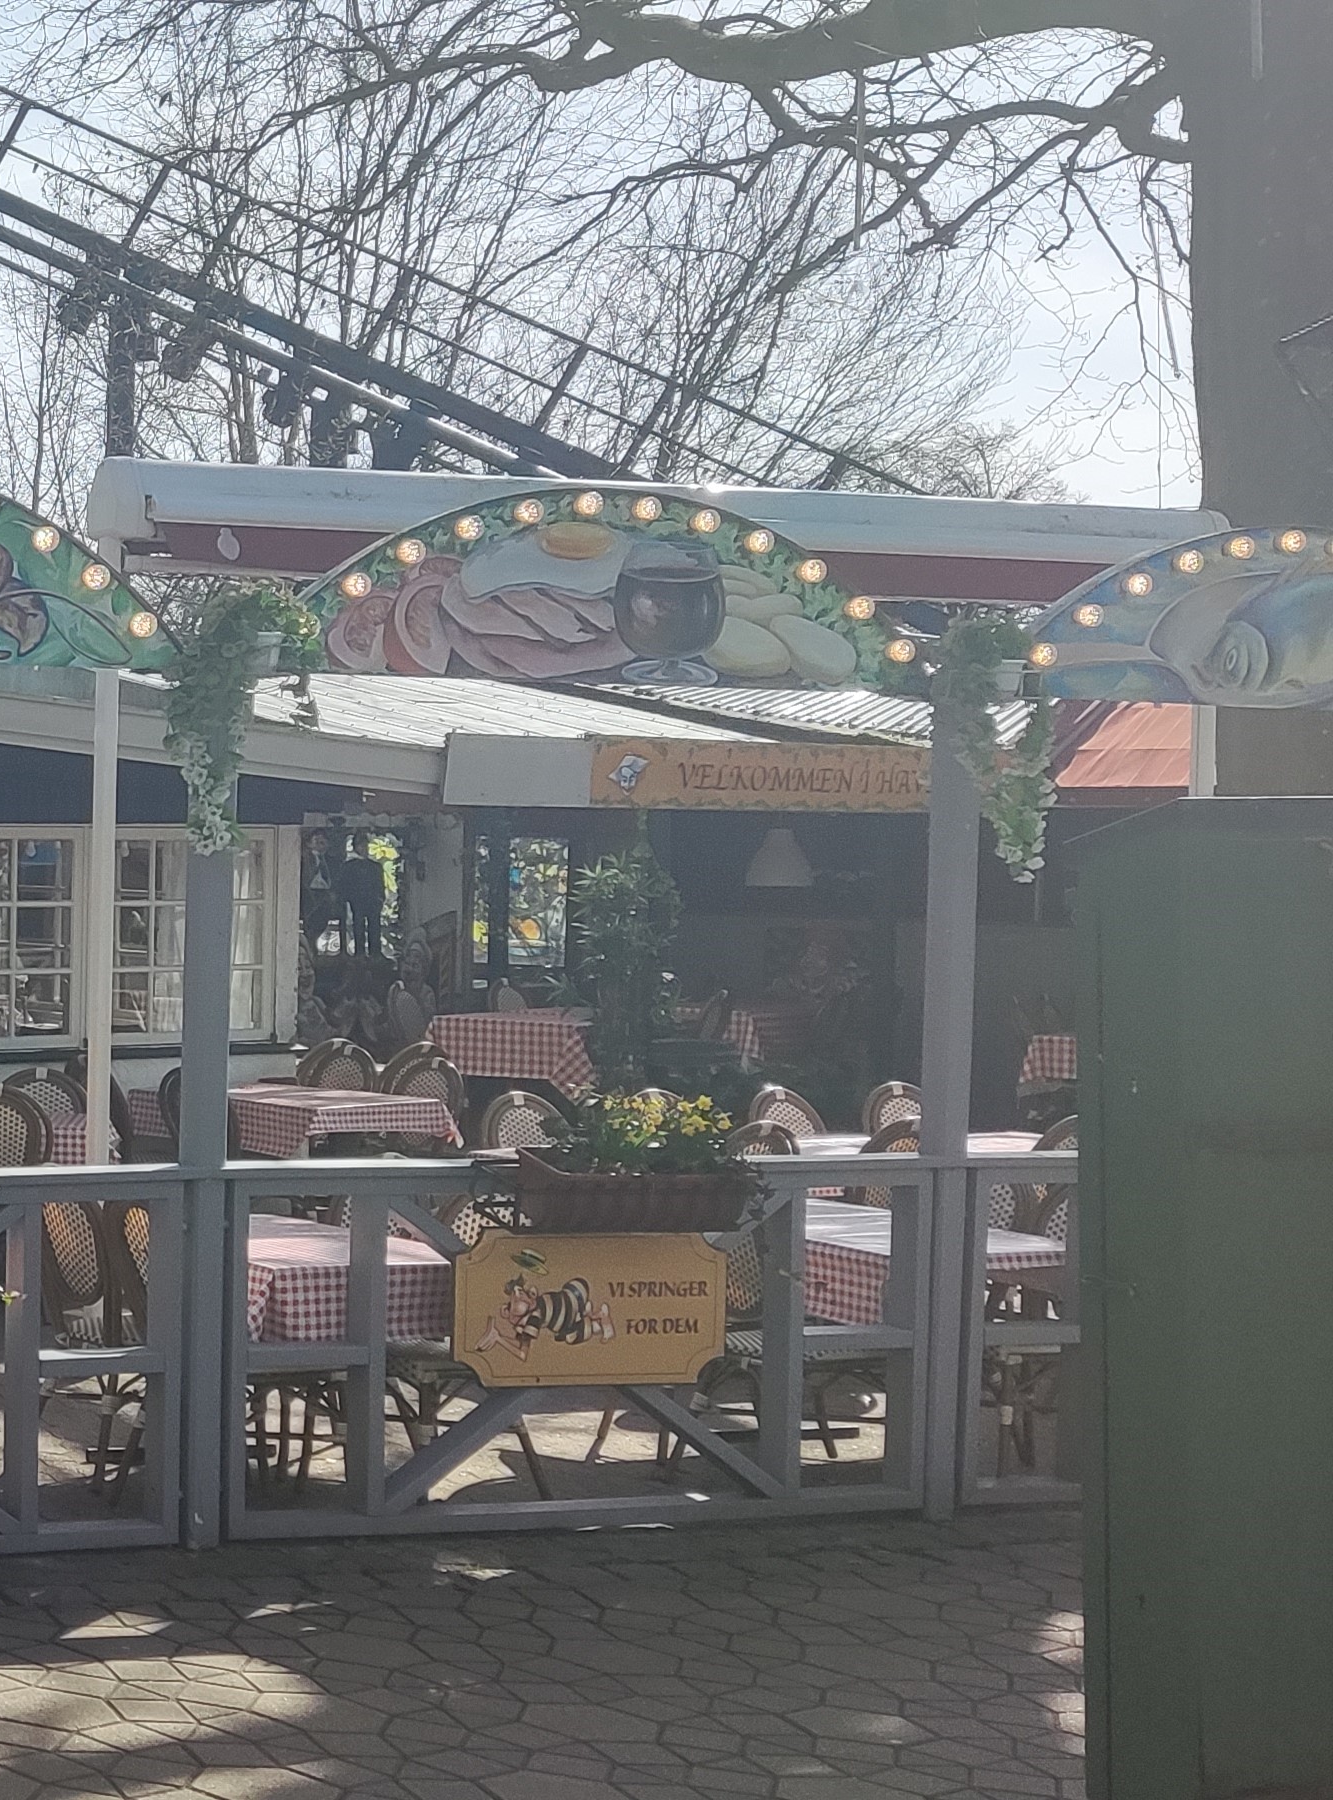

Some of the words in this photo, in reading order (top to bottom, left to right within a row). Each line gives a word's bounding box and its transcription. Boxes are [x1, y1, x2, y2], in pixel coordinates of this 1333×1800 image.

[677, 761, 860, 793] VELKOMMEN
[608, 1281, 626, 1298] VI
[627, 1281, 709, 1298] SPRINGER
[626, 1317, 659, 1335] FOR
[661, 1318, 700, 1334] DEM
